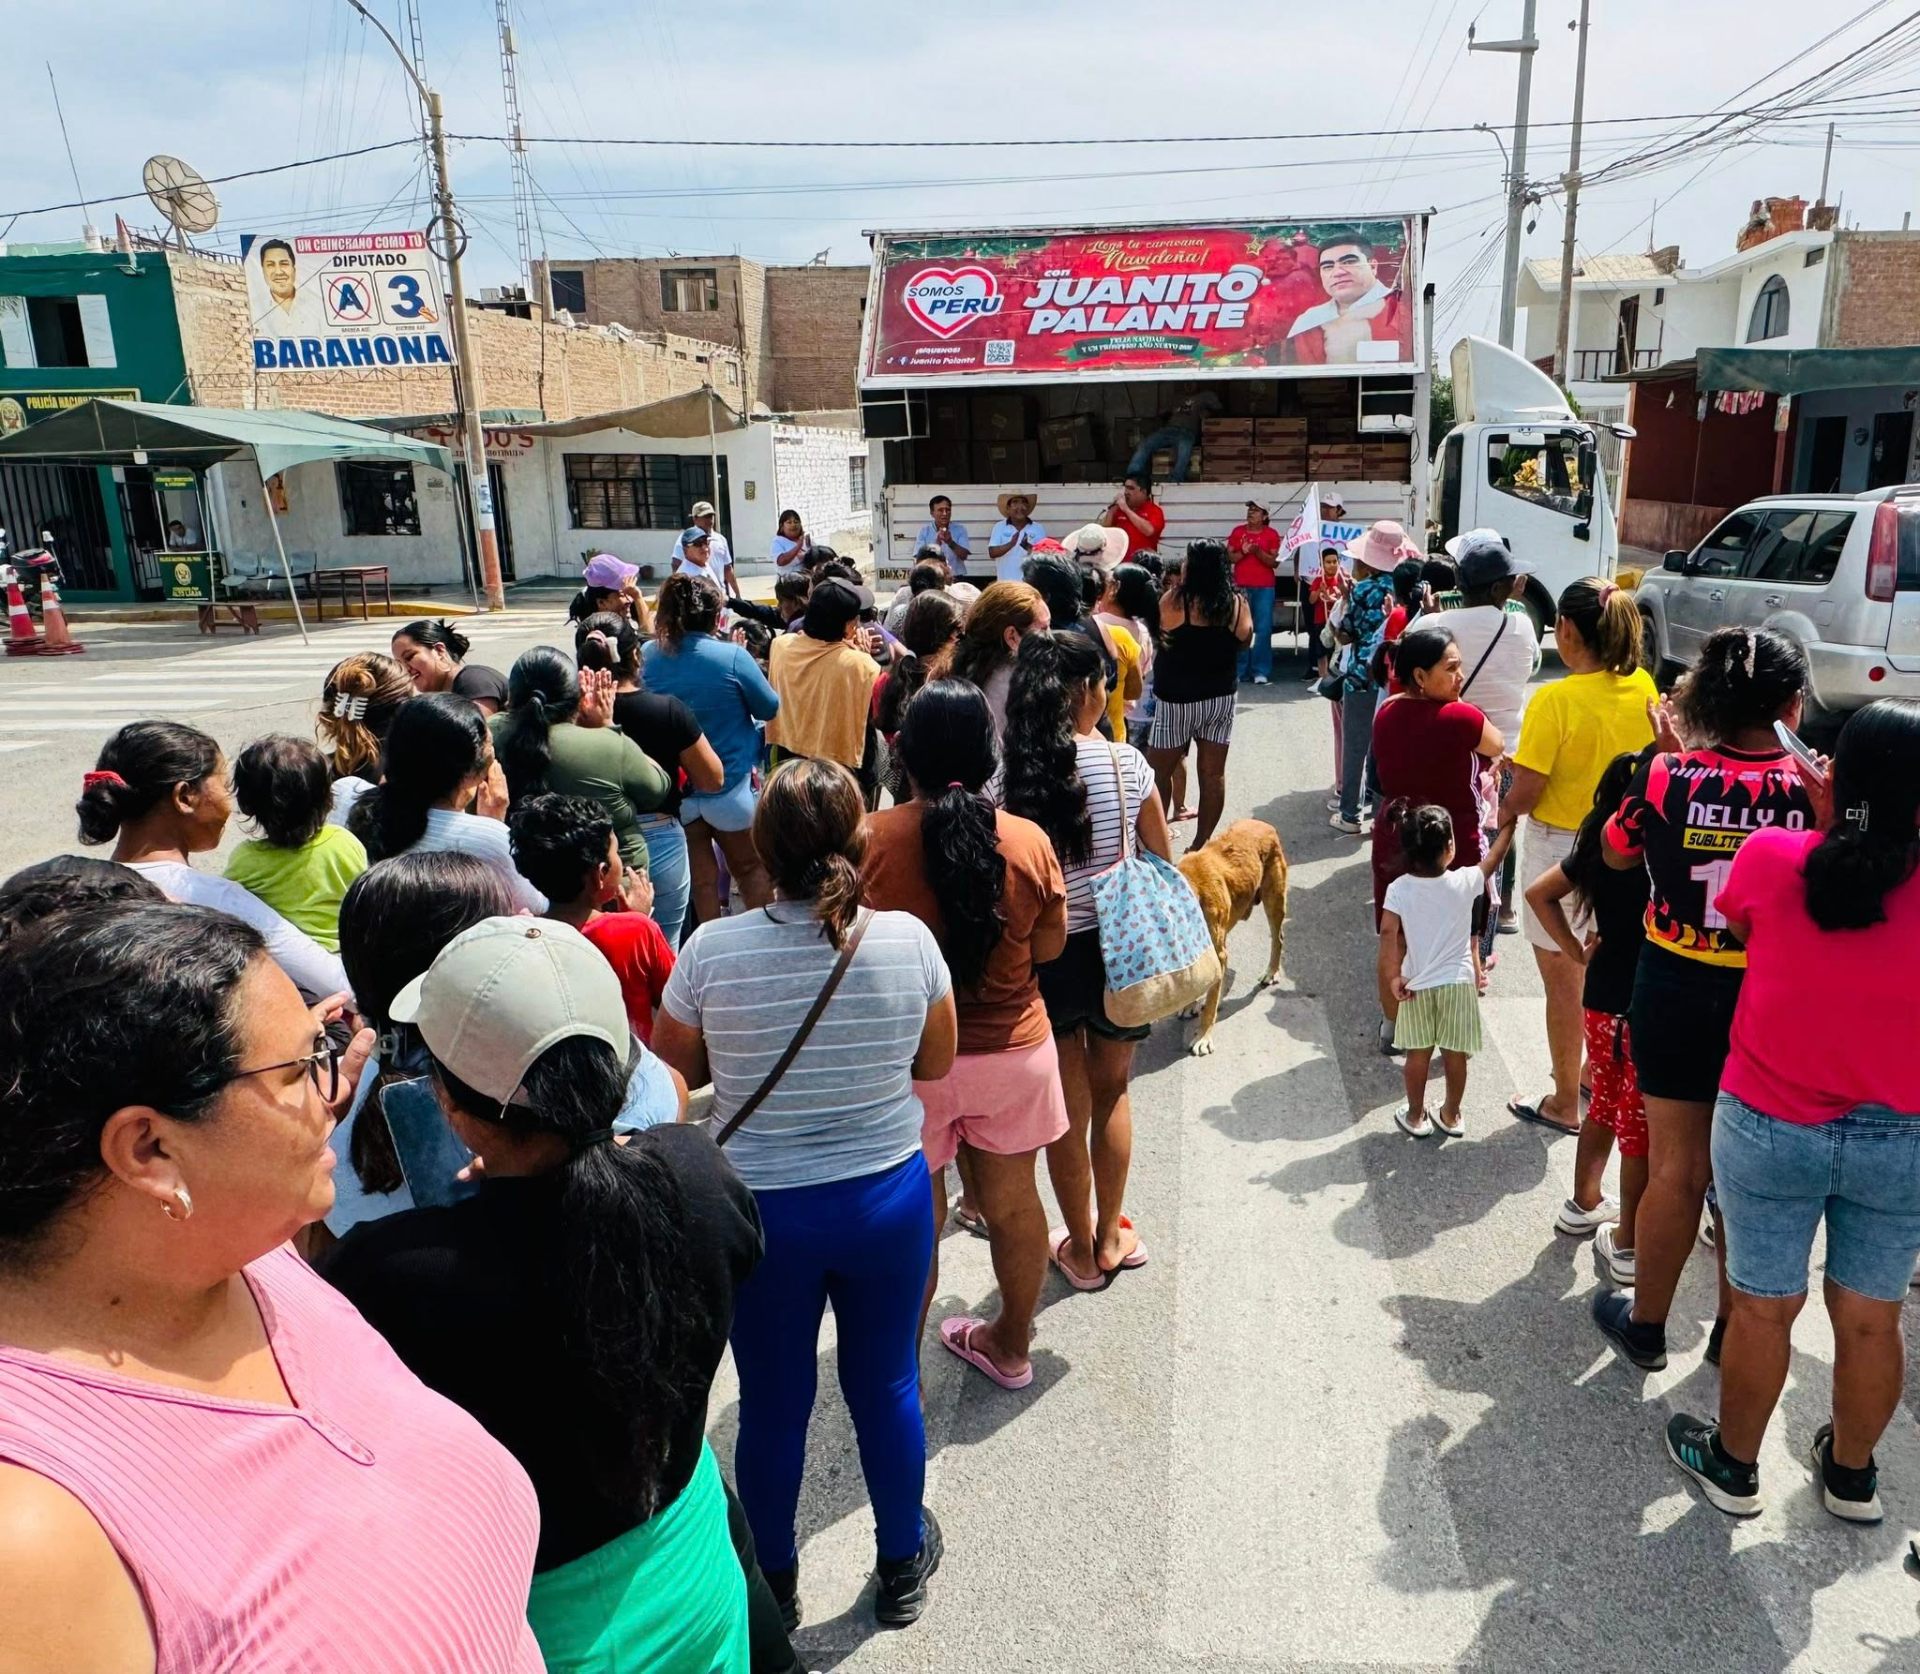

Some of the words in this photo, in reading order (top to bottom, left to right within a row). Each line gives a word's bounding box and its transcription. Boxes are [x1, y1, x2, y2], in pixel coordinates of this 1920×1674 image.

[297, 239, 312, 252] UN
[374, 234, 405, 249] COMO
[333, 253, 407, 267] DIPUTADO
[1043, 269, 1071, 277] con
[339, 283, 364, 311] A
[387, 275, 425, 319] 3
[908, 286, 964, 297] SOMOS
[1022, 271, 1258, 308] JUANITO
[927, 297, 1001, 315] PERU
[1027, 303, 1249, 335] PALANTE
[254, 334, 450, 369] BARAHONA
[26, 395, 58, 409] POLICÍA
[879, 569, 910, 579] BMX-7
[1686, 801, 1775, 829] NELLY
